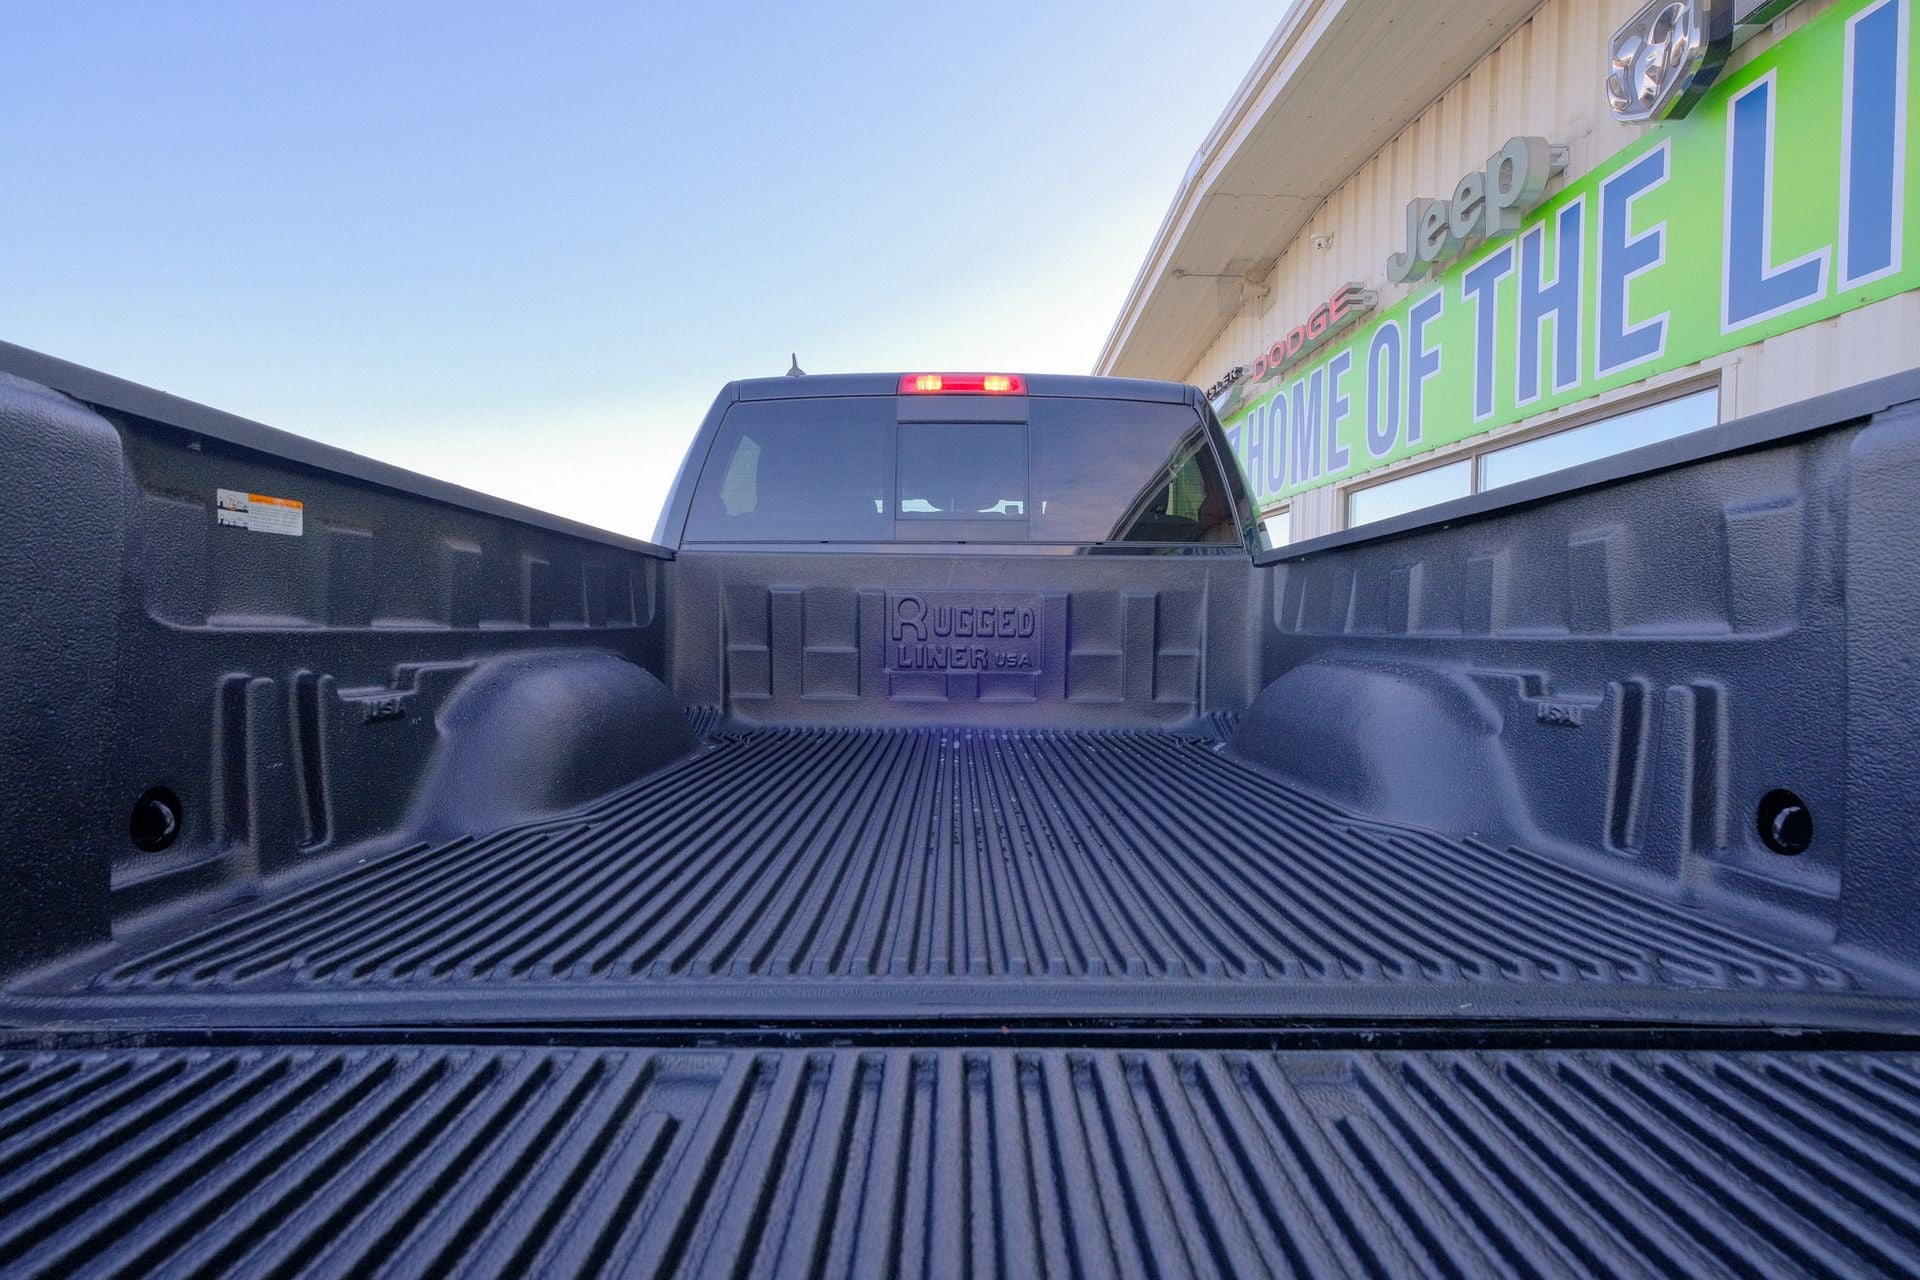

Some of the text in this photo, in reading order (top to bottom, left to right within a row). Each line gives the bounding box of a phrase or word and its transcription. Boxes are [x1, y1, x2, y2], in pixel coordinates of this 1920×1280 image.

[1387, 136, 1546, 284] Jeep
[1247, 343, 1352, 502] HOME
[1366, 285, 1444, 460] OF
[1461, 135, 1672, 424] THE
[1250, 282, 1356, 383] DODGE
[892, 593, 1035, 642] RUGGED
[897, 643, 1033, 670] LINER USA
